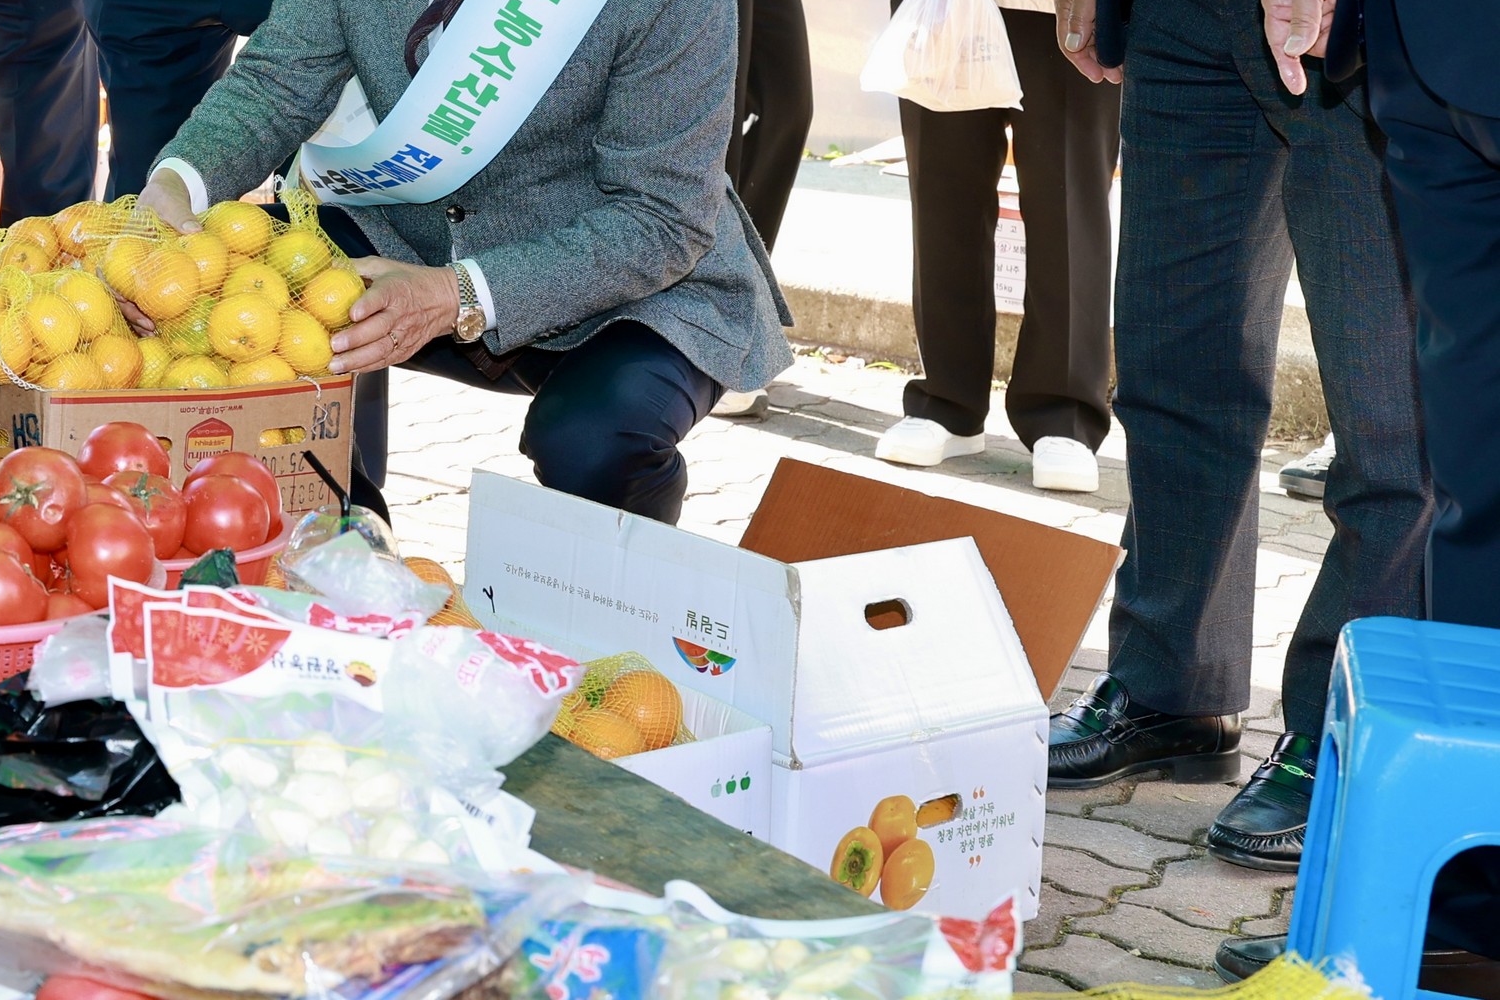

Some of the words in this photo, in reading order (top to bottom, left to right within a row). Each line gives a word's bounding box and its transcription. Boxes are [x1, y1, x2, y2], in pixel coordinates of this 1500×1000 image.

[179, 404, 244, 415] www.스미후루.com
[533, 571, 560, 589] 냉장보관
[561, 581, 576, 595] 즉시
[592, 592, 614, 608] 위하여
[615, 599, 637, 616] 유지를
[638, 608, 660, 624] 신선도
[686, 610, 729, 640] 드림빌
[978, 802, 995, 816] 가득
[937, 827, 954, 843] 청정
[956, 818, 989, 838] 자연에서
[991, 812, 1015, 830] 키워낸
[959, 837, 976, 853] 장성
[978, 833, 995, 849] 명품
